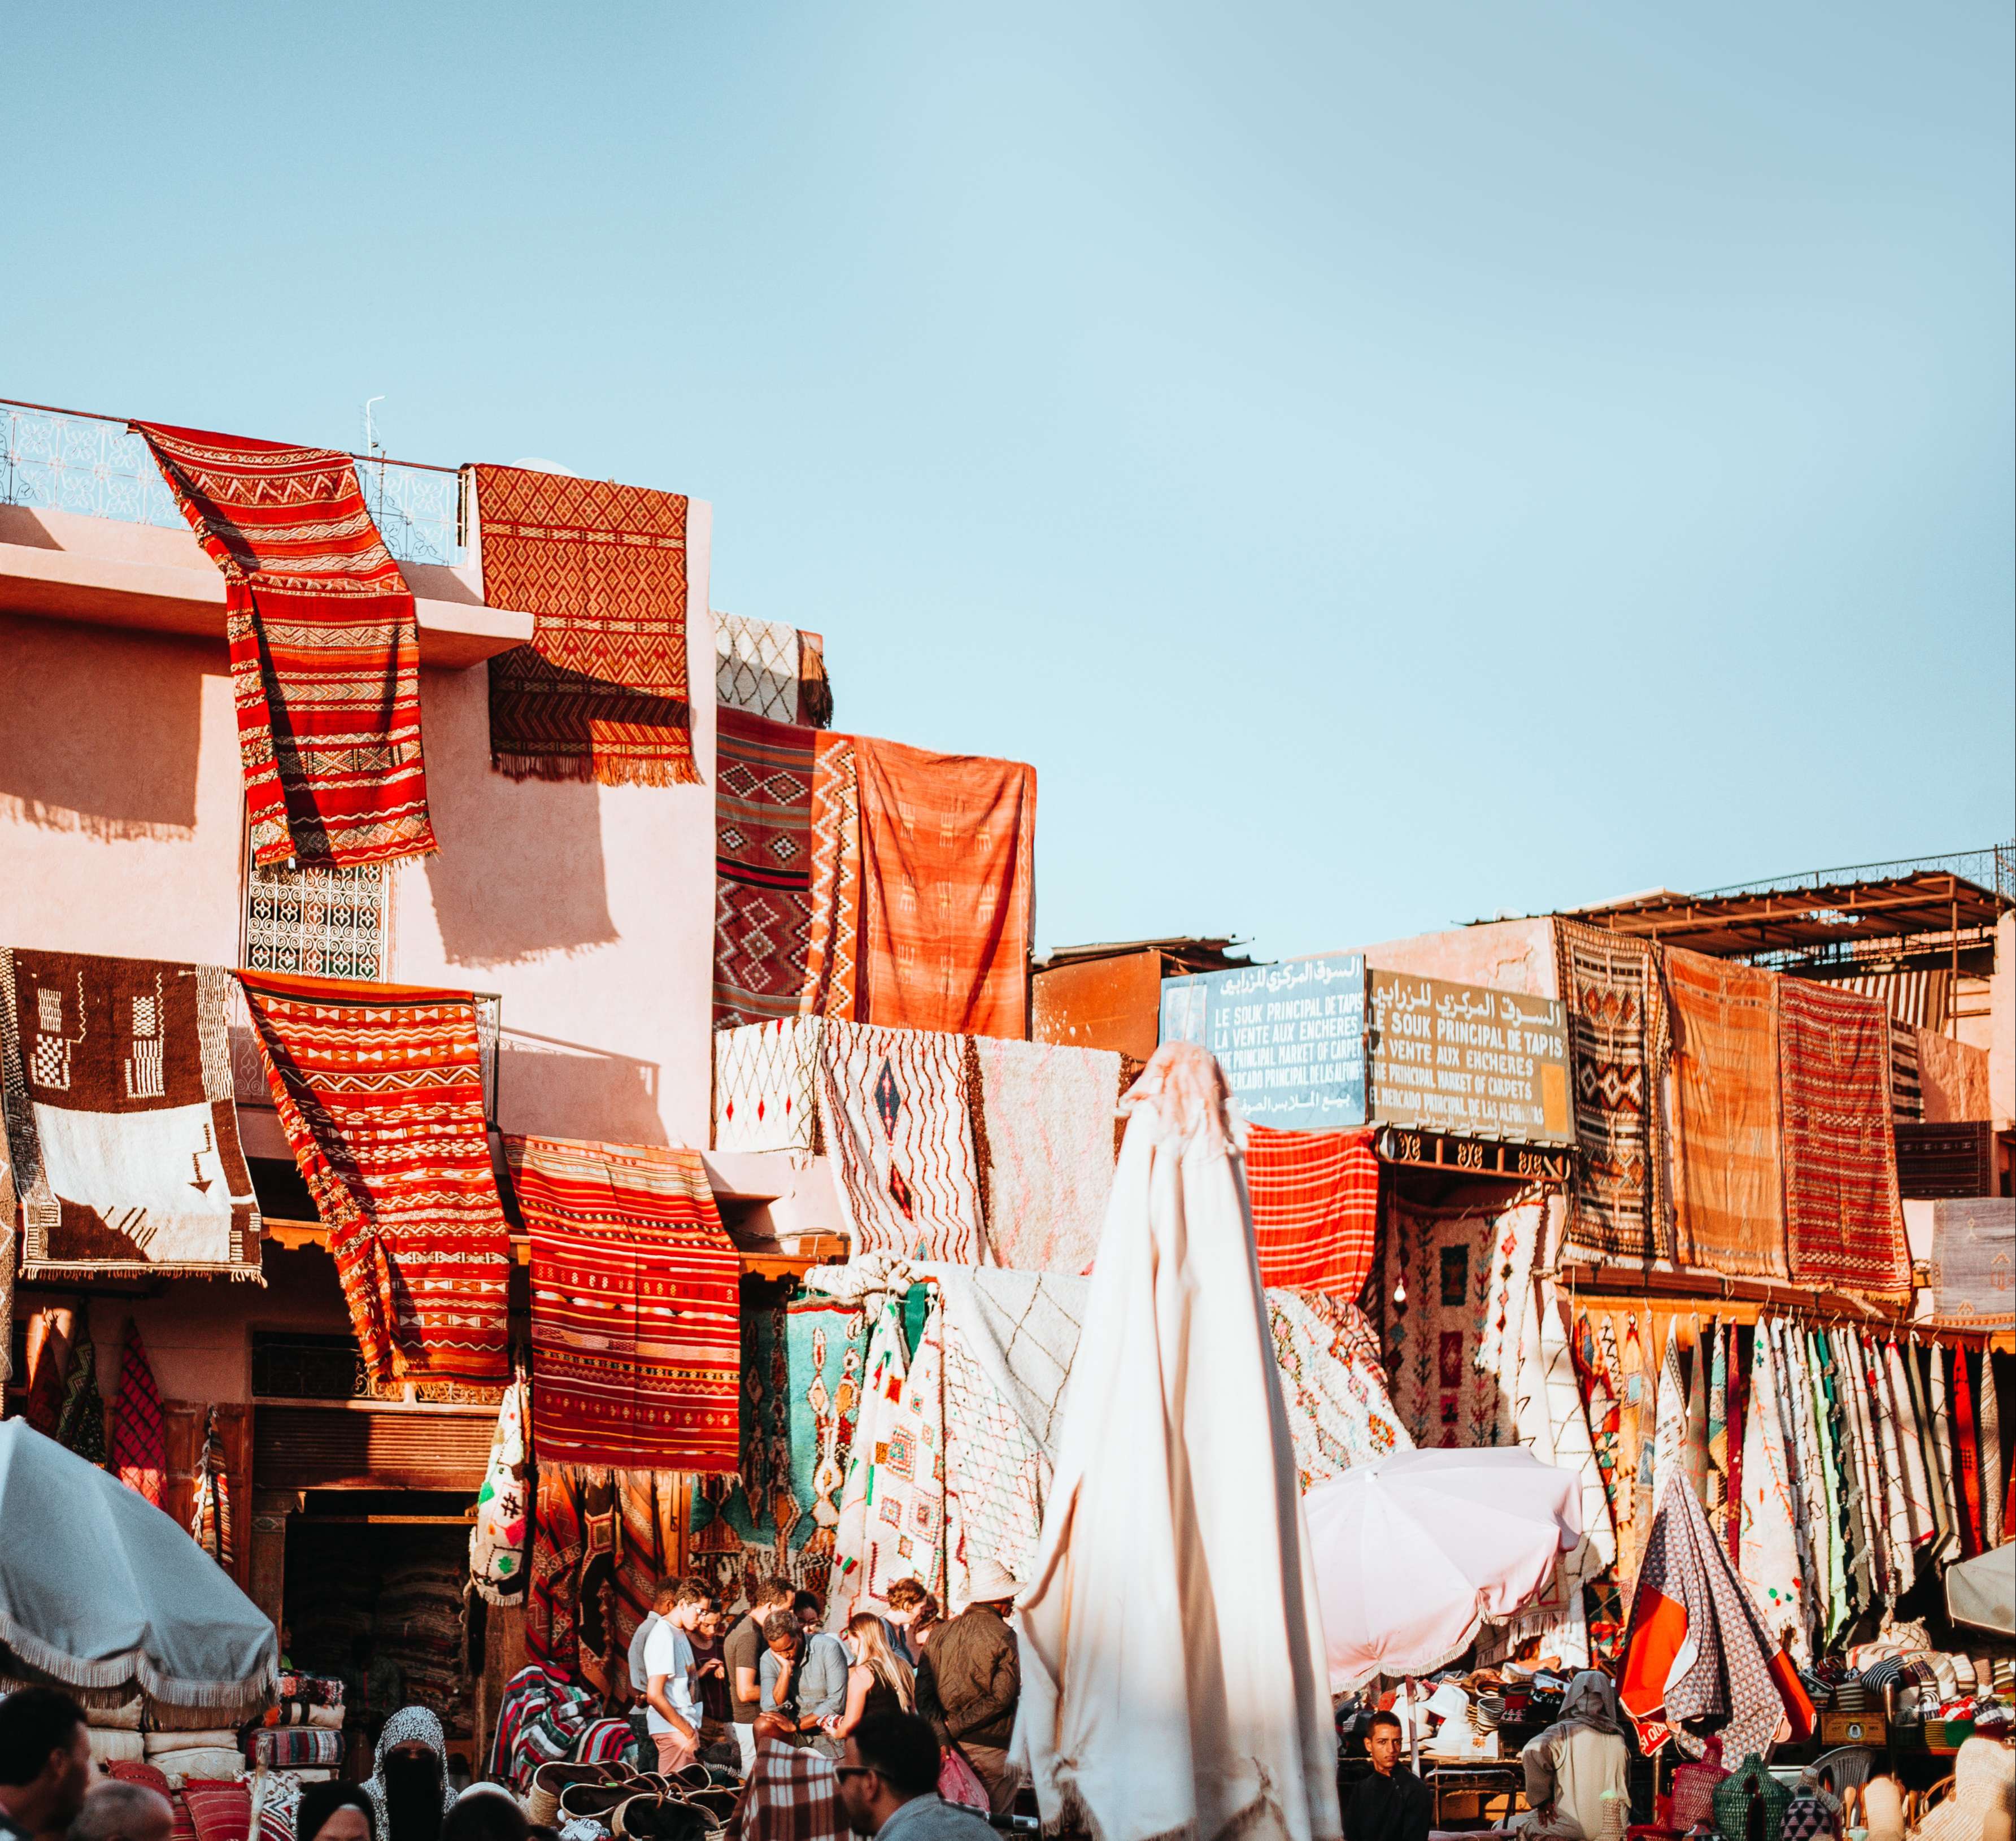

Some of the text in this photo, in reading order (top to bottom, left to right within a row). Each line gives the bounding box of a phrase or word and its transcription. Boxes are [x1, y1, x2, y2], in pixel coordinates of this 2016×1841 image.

[1314, 956, 1360, 985] السوق
[1215, 993, 1363, 1028] LE SOUK PRINCIPAL DE TAPIS
[1435, 991, 1495, 1020] المركزي
[1500, 995, 1561, 1028] السوق
[1214, 1016, 1358, 1050] LA VENTE AUX ENCHERES
[1368, 1008, 1563, 1058] LE SOUK PRINCIPAL DE TAPIS
[1216, 1051, 1232, 1070] THE
[1233, 1046, 1276, 1069] PRINCIPAL
[1278, 1042, 1314, 1065] MARKET
[1317, 1041, 1329, 1061] OF
[1368, 1036, 1534, 1077] LA VENTE AUX ENCHERES
[1264, 1064, 1309, 1089] PRINCIPAL
[1368, 1060, 1532, 1100] THE PRINCIPAL MARKET OF CARPETS
[1369, 1085, 1381, 1106] EL
[1381, 1086, 1421, 1111] MERCADO
[1423, 1093, 1468, 1117] PRINCIPAL
[1468, 1098, 1480, 1118] DE
[1481, 1099, 1498, 1121] LAS
